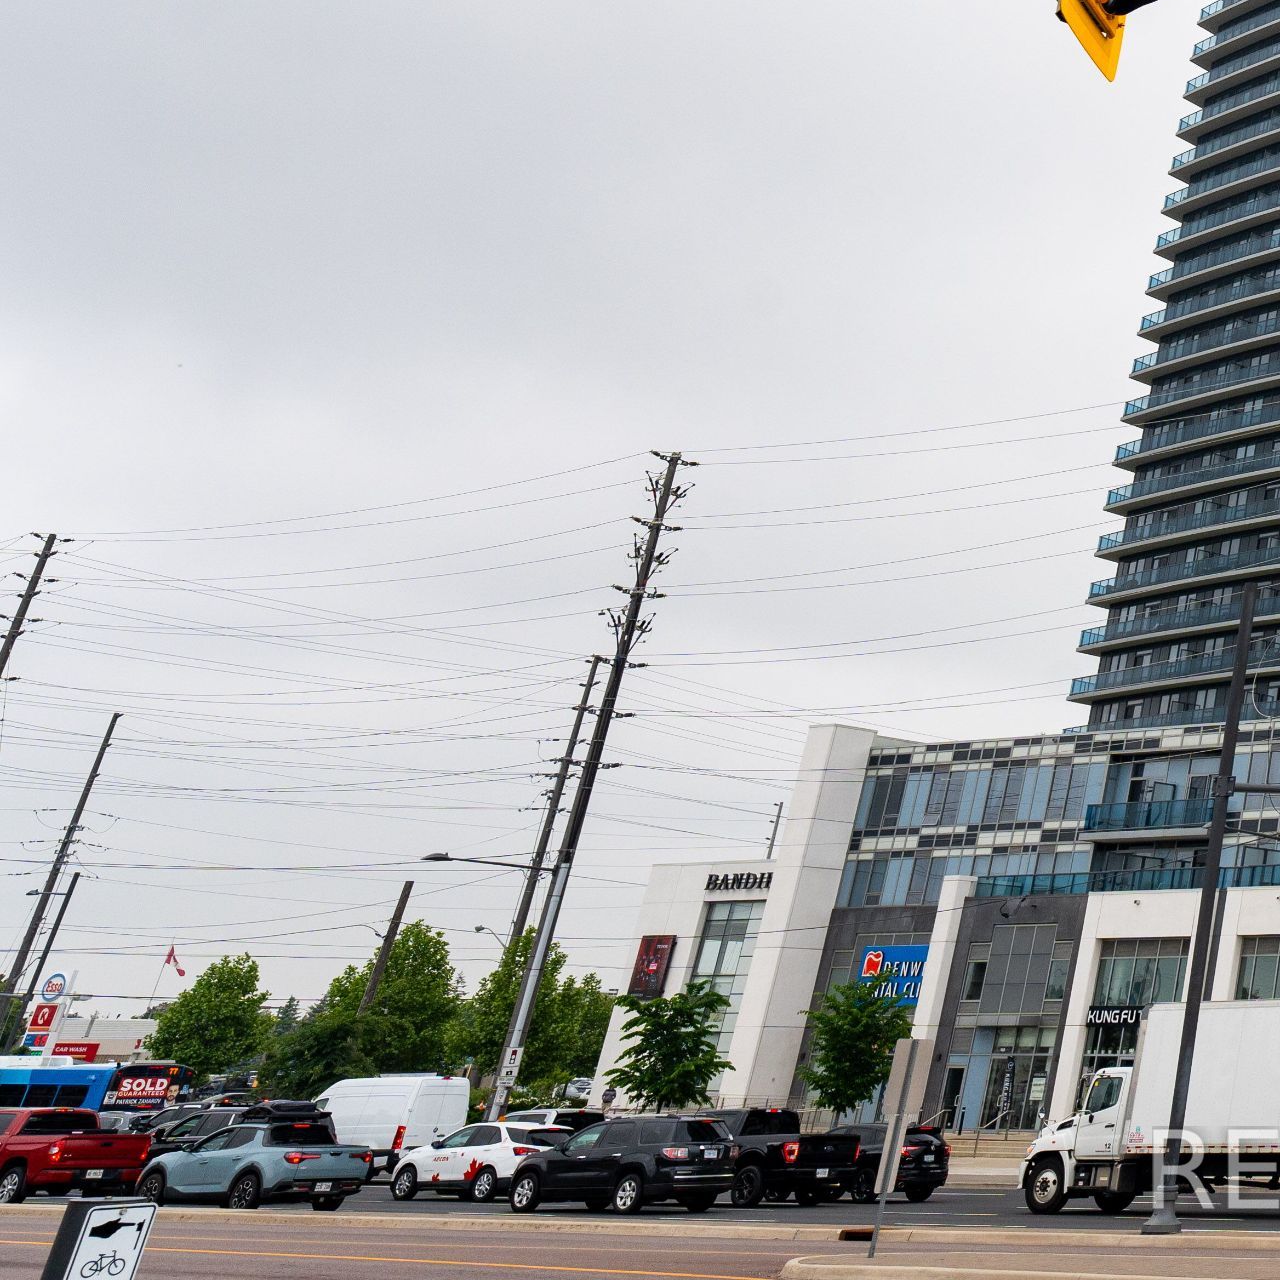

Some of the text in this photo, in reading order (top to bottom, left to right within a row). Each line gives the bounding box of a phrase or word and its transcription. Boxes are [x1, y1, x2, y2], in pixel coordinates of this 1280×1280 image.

[1087, 1009, 1120, 1024] KUNG
[1120, 1009, 1137, 1023] FU
[121, 1078, 168, 1091] SOLD
